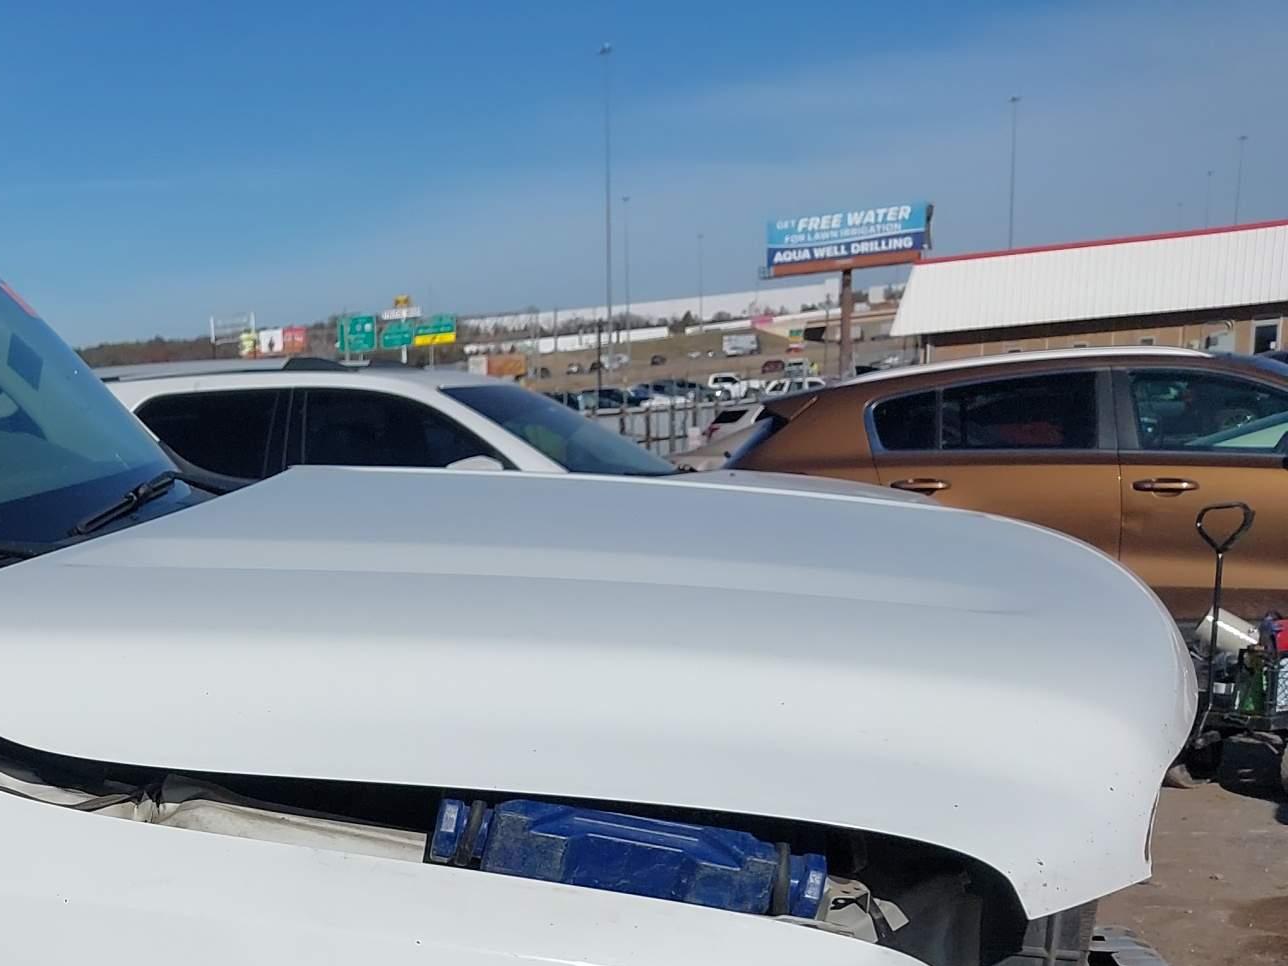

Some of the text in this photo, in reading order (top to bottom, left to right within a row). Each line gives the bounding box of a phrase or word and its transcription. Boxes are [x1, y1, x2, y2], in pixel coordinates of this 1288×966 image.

[797, 213, 843, 232] FREE
[847, 205, 911, 226] WATER
[773, 236, 914, 264] AQUA WELL DRILLING
